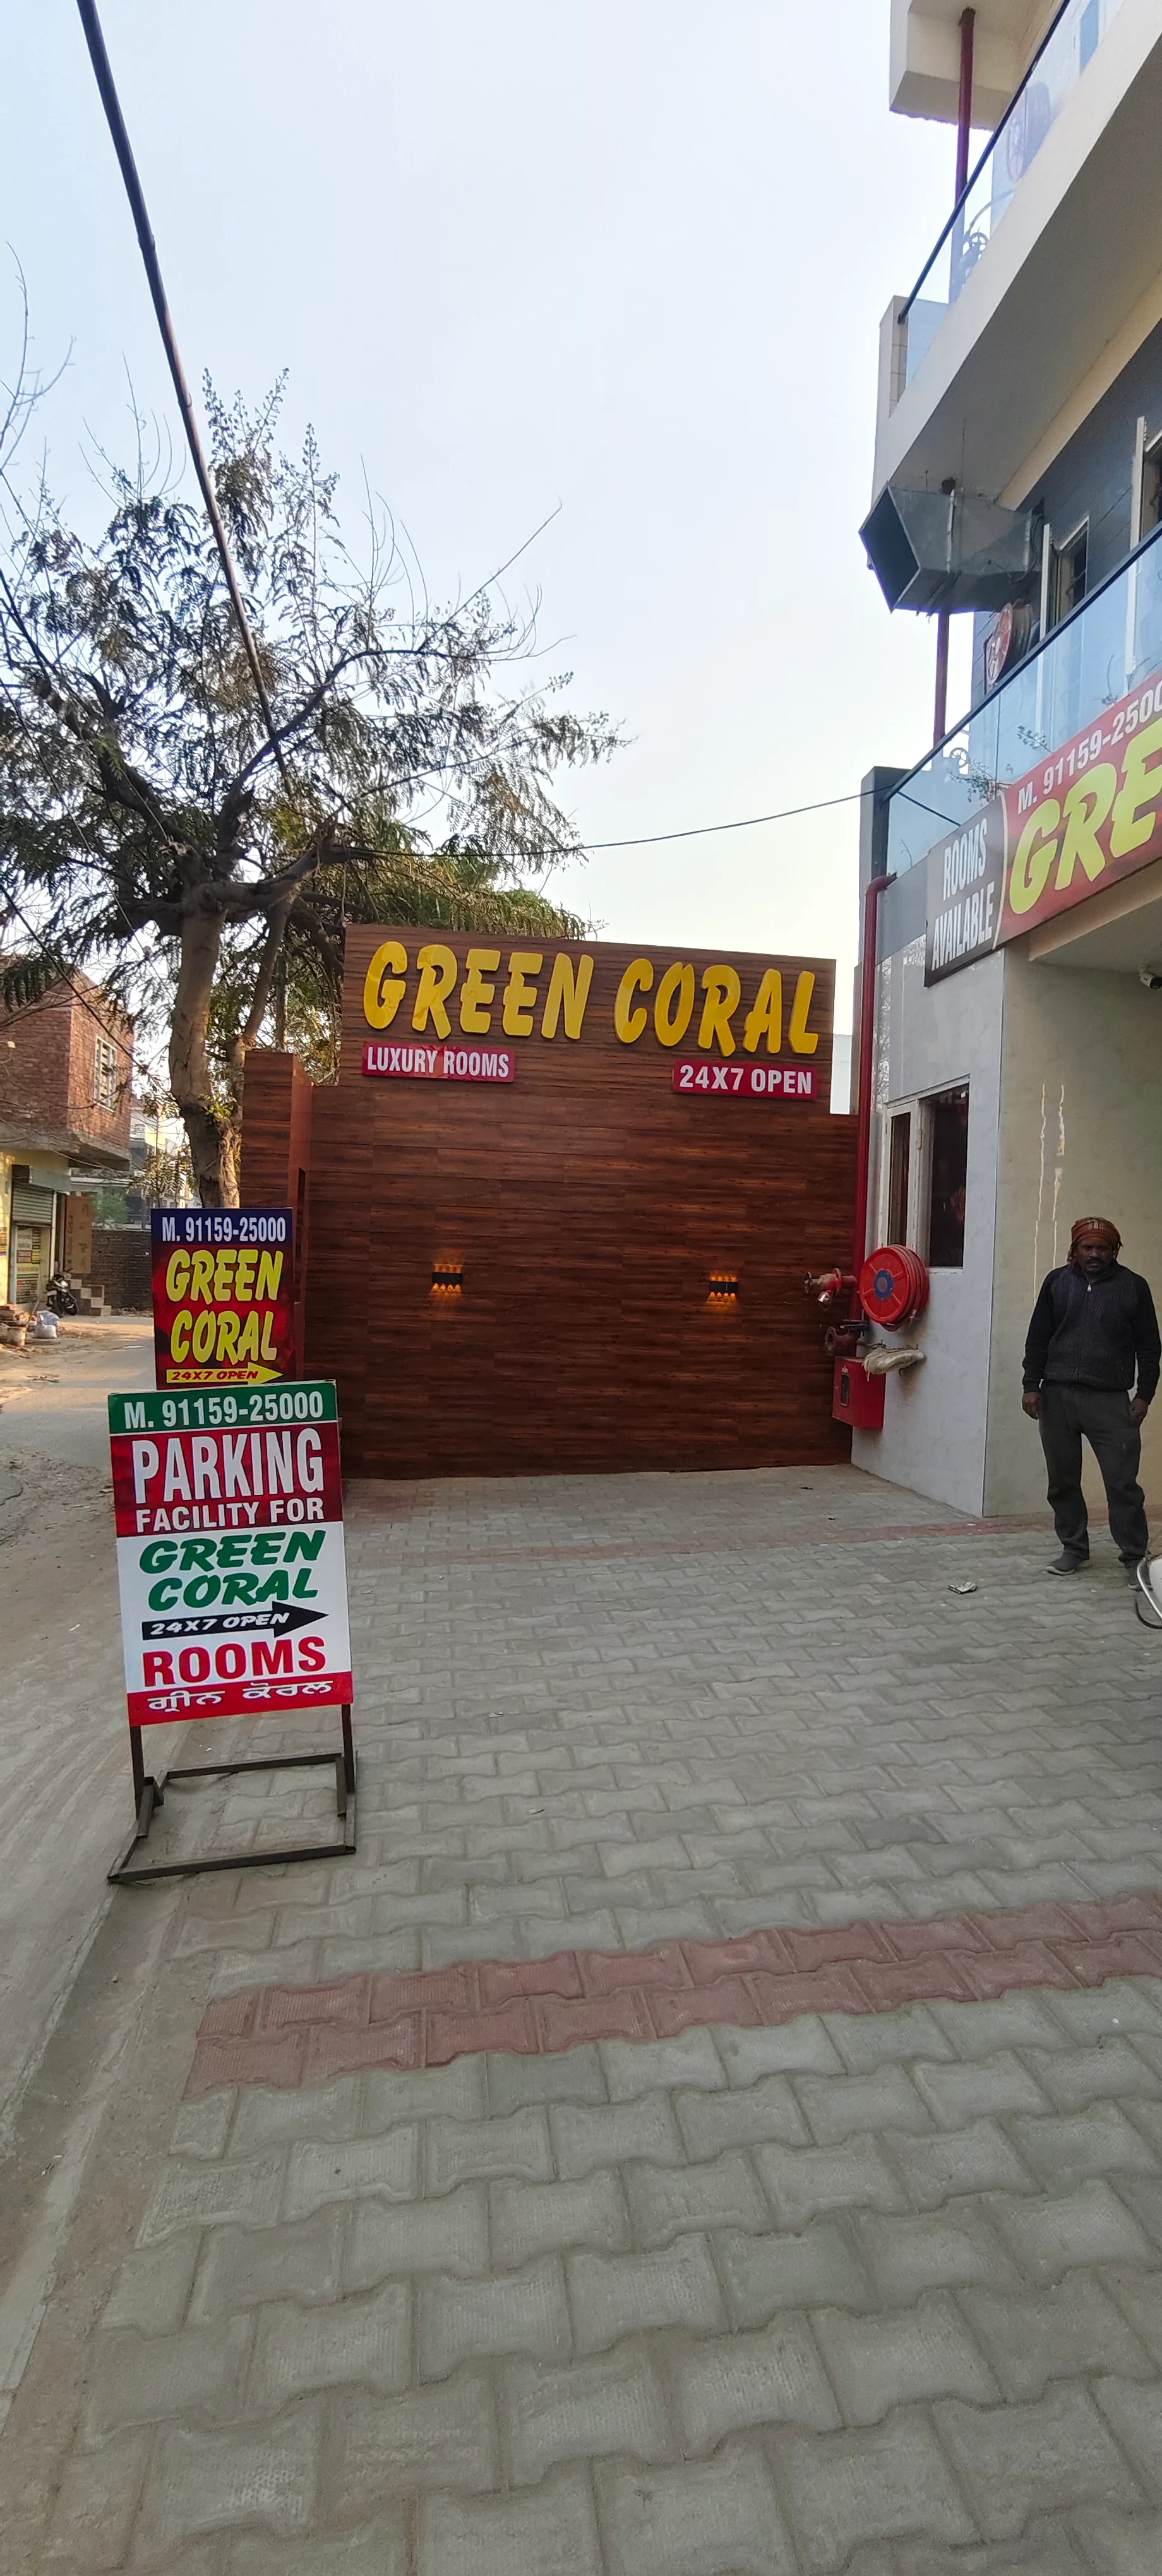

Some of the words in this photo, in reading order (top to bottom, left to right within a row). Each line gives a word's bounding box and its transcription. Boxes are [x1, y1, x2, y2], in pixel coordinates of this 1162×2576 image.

[1009, 717, 1162, 915] GRE
[1017, 781, 1037, 815] M.
[943, 818, 987, 901] ROOMS
[931, 881, 995, 972] AVAILABLE
[363, 941, 594, 1040] GREEN
[614, 958, 818, 1058] CORAL
[368, 1046, 438, 1073] LUXURY
[443, 1051, 509, 1078] ROOMS
[680, 1064, 745, 1091] 24X7
[751, 1068, 812, 1095] OPEN
[162, 1217, 181, 1242] M.
[186, 1217, 285, 1242] 91159-25000
[165, 1248, 284, 1304] GREEN
[170, 1309, 277, 1366] CORAL
[172, 1371, 213, 1381] 24X7
[217, 1371, 258, 1380] OPEN
[124, 1401, 154, 1429] M.
[162, 1391, 323, 1428] 91159-25000
[131, 1428, 324, 1504] PARKING
[136, 1502, 258, 1533] FACILITY
[270, 1497, 325, 1524] FOR
[139, 1530, 326, 1573] GREEN
[148, 1568, 318, 1611] CORAL
[150, 1618, 217, 1635] 24X7
[222, 1612, 290, 1628] OPEN
[143, 1636, 326, 1687] ROOMS
